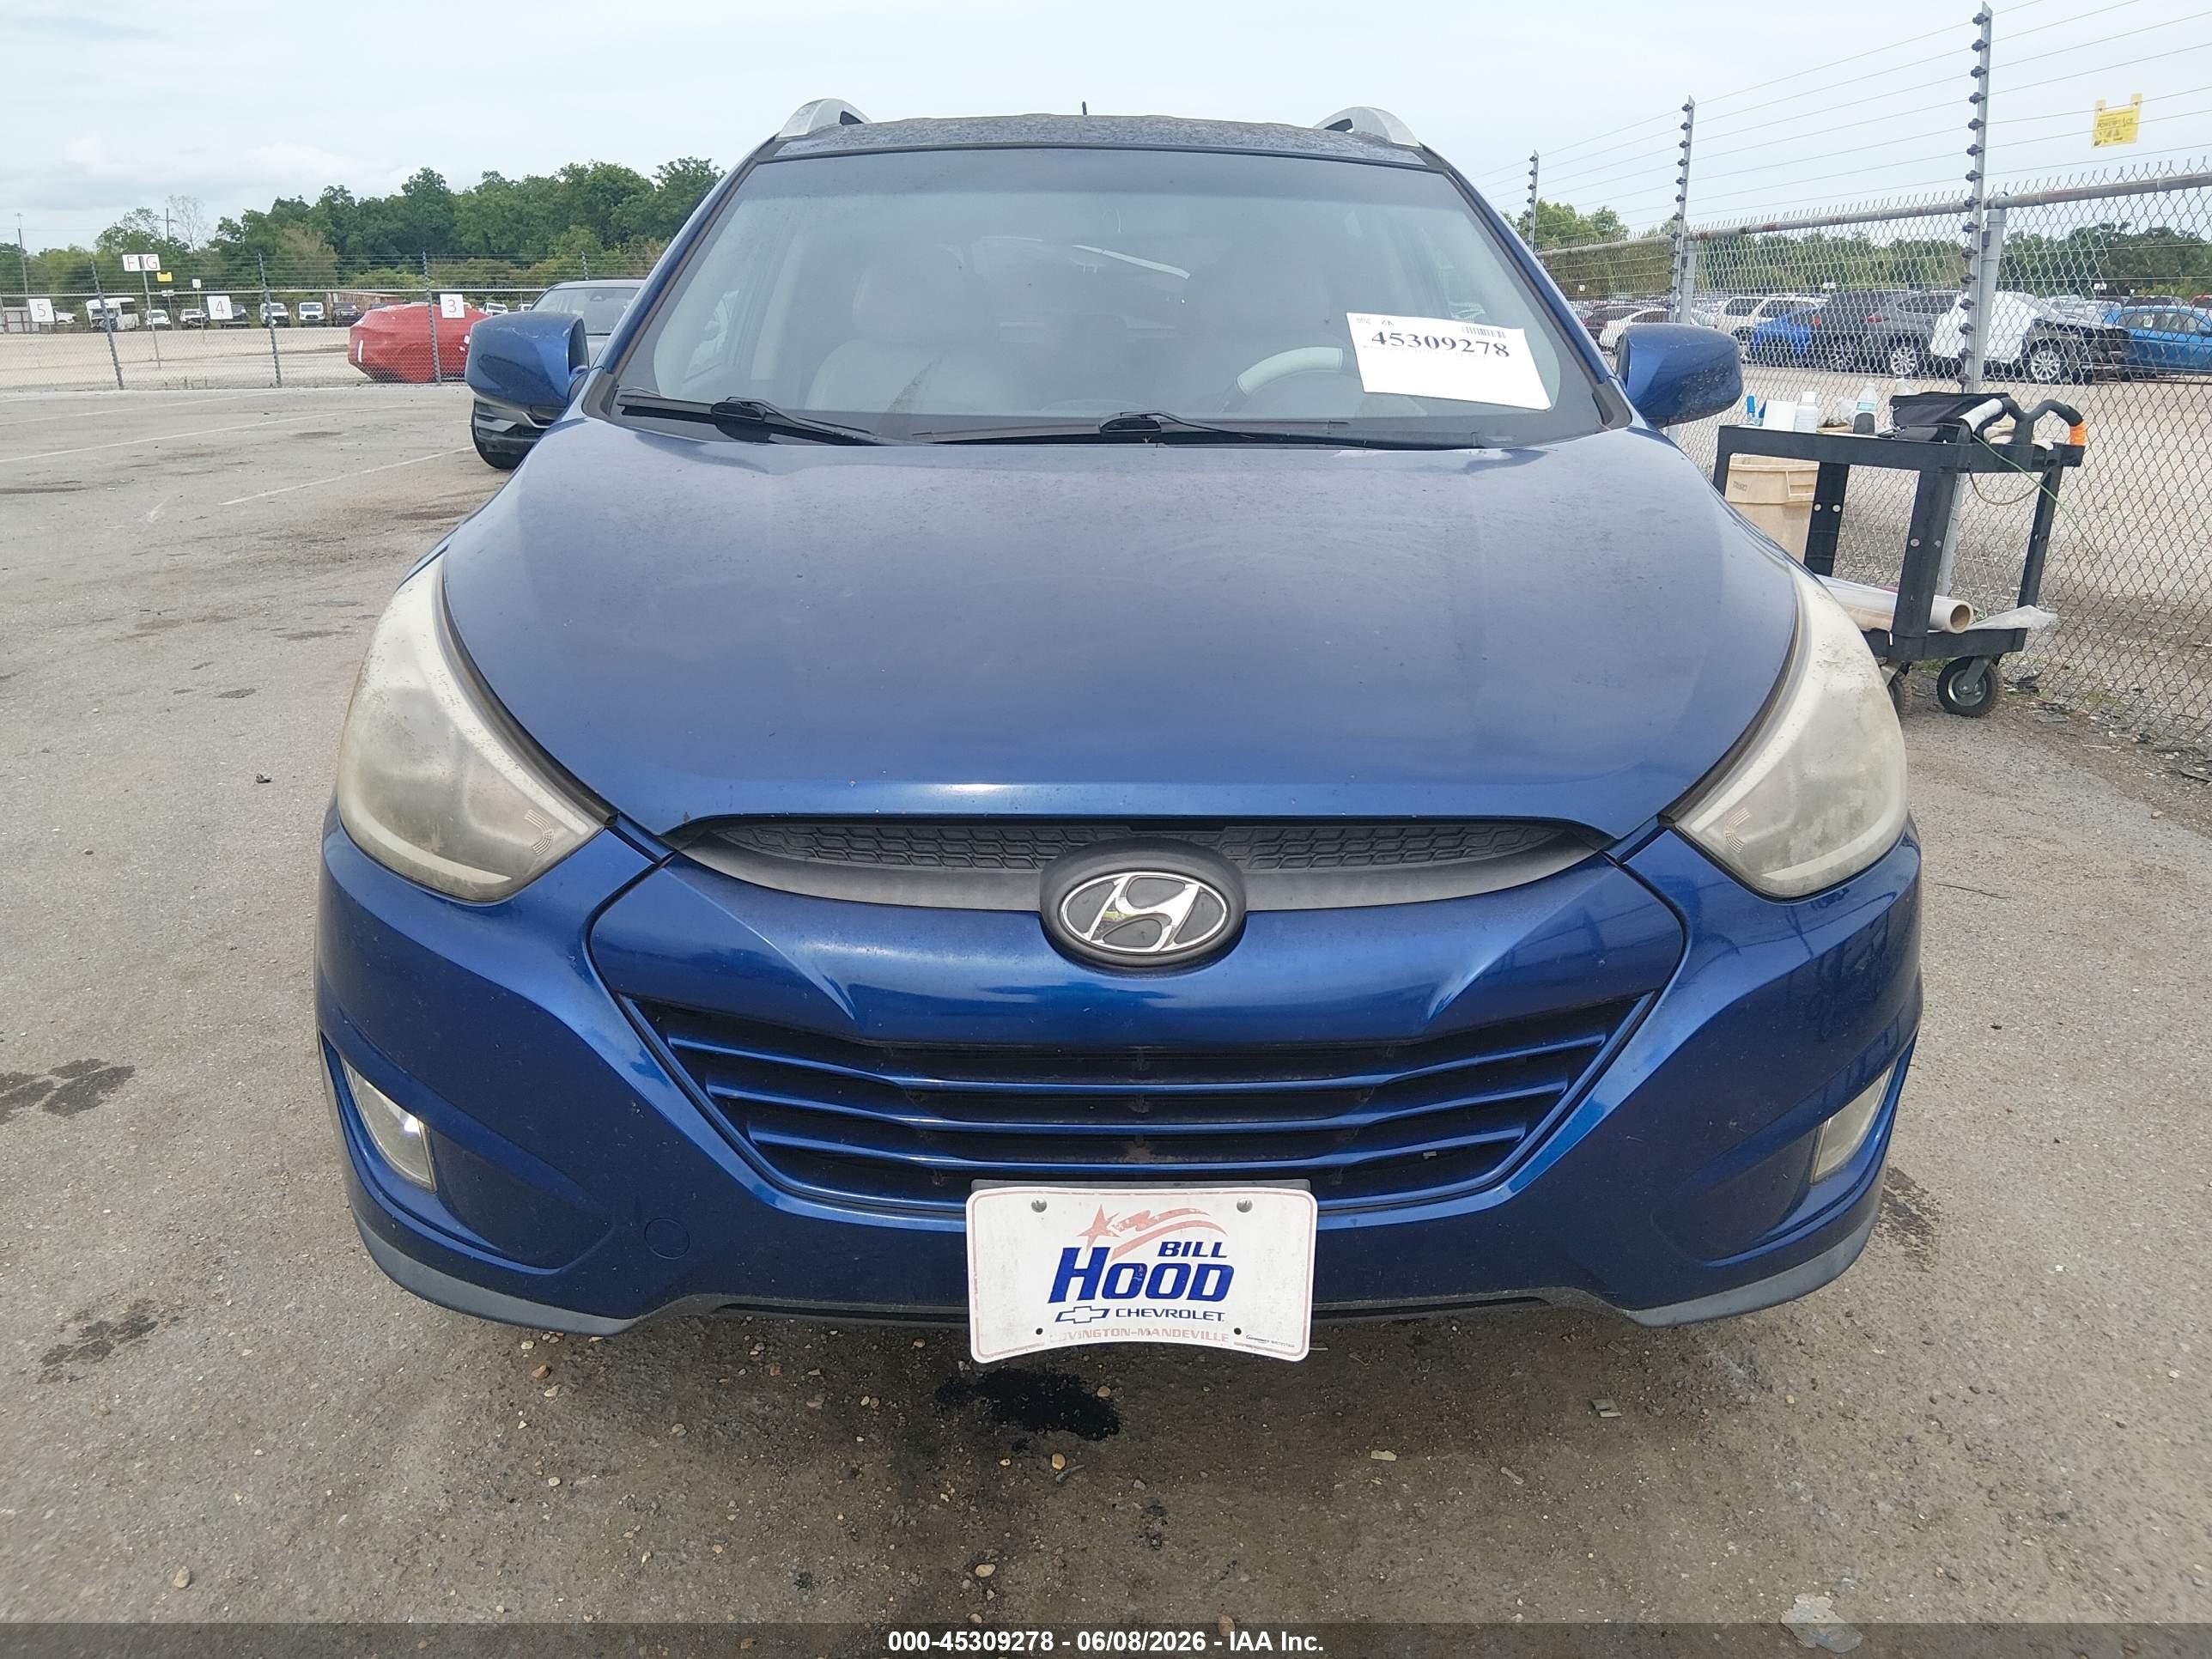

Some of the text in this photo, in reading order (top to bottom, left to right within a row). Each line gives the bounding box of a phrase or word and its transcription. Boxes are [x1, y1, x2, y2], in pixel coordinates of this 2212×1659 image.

[37, 302, 46, 317] 5
[216, 301, 227, 314] 4
[447, 299, 457, 313] 3
[1371, 331, 1510, 358] 45309278
[1157, 1241, 1228, 1259] BILL
[1048, 1246, 1235, 1304] HOOD
[1115, 1308, 1225, 1322] CHEVROLET
[1050, 1328, 1230, 1343] VINGTON-MANDEVILLE
